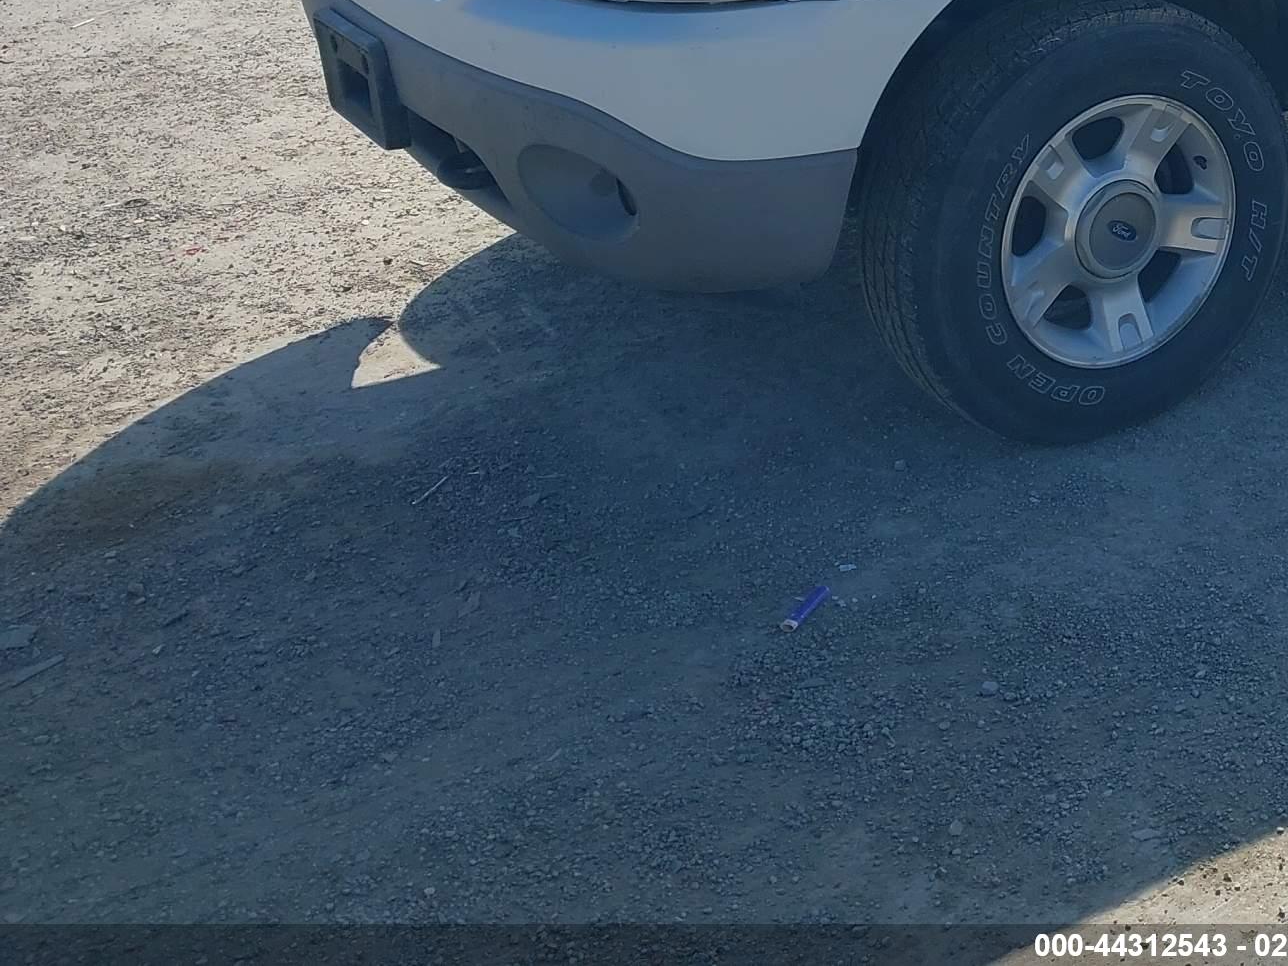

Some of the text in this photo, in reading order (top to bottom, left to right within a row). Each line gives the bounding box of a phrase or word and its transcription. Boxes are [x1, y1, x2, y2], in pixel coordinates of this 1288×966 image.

[977, 133, 1106, 406] OPEN COUNTRY
[1180, 70, 1268, 282] TOYO H/T
